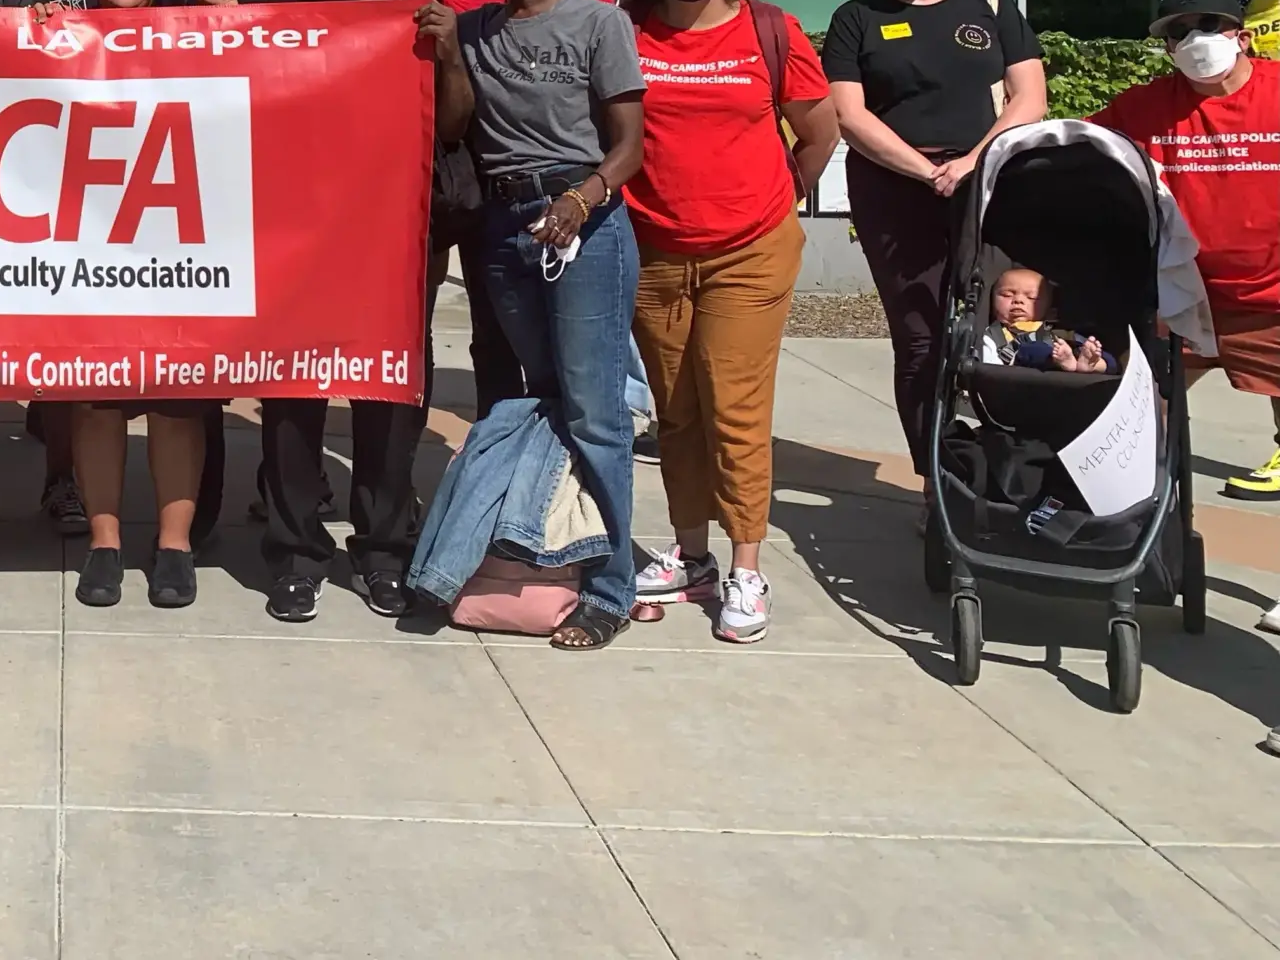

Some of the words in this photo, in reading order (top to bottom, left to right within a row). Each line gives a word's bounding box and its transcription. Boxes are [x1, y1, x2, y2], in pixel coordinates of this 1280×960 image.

[17, 23, 85, 51] LA
[104, 24, 329, 55] Chapter
[518, 45, 575, 68] Nah.
[671, 62, 717, 72] CAMPUS
[540, 71, 575, 84] 1955
[1192, 134, 1238, 145] CAMPUS
[1177, 147, 1226, 158] ABOLISH
[1228, 147, 1249, 157] ICE
[72, 257, 230, 289] Association
[26, 352, 132, 388] Contract
[155, 353, 206, 386] Free
[213, 350, 284, 385] Public
[291, 347, 374, 390] Higher
[381, 350, 408, 385] Ed
[1078, 414, 1131, 476] MENTAL
